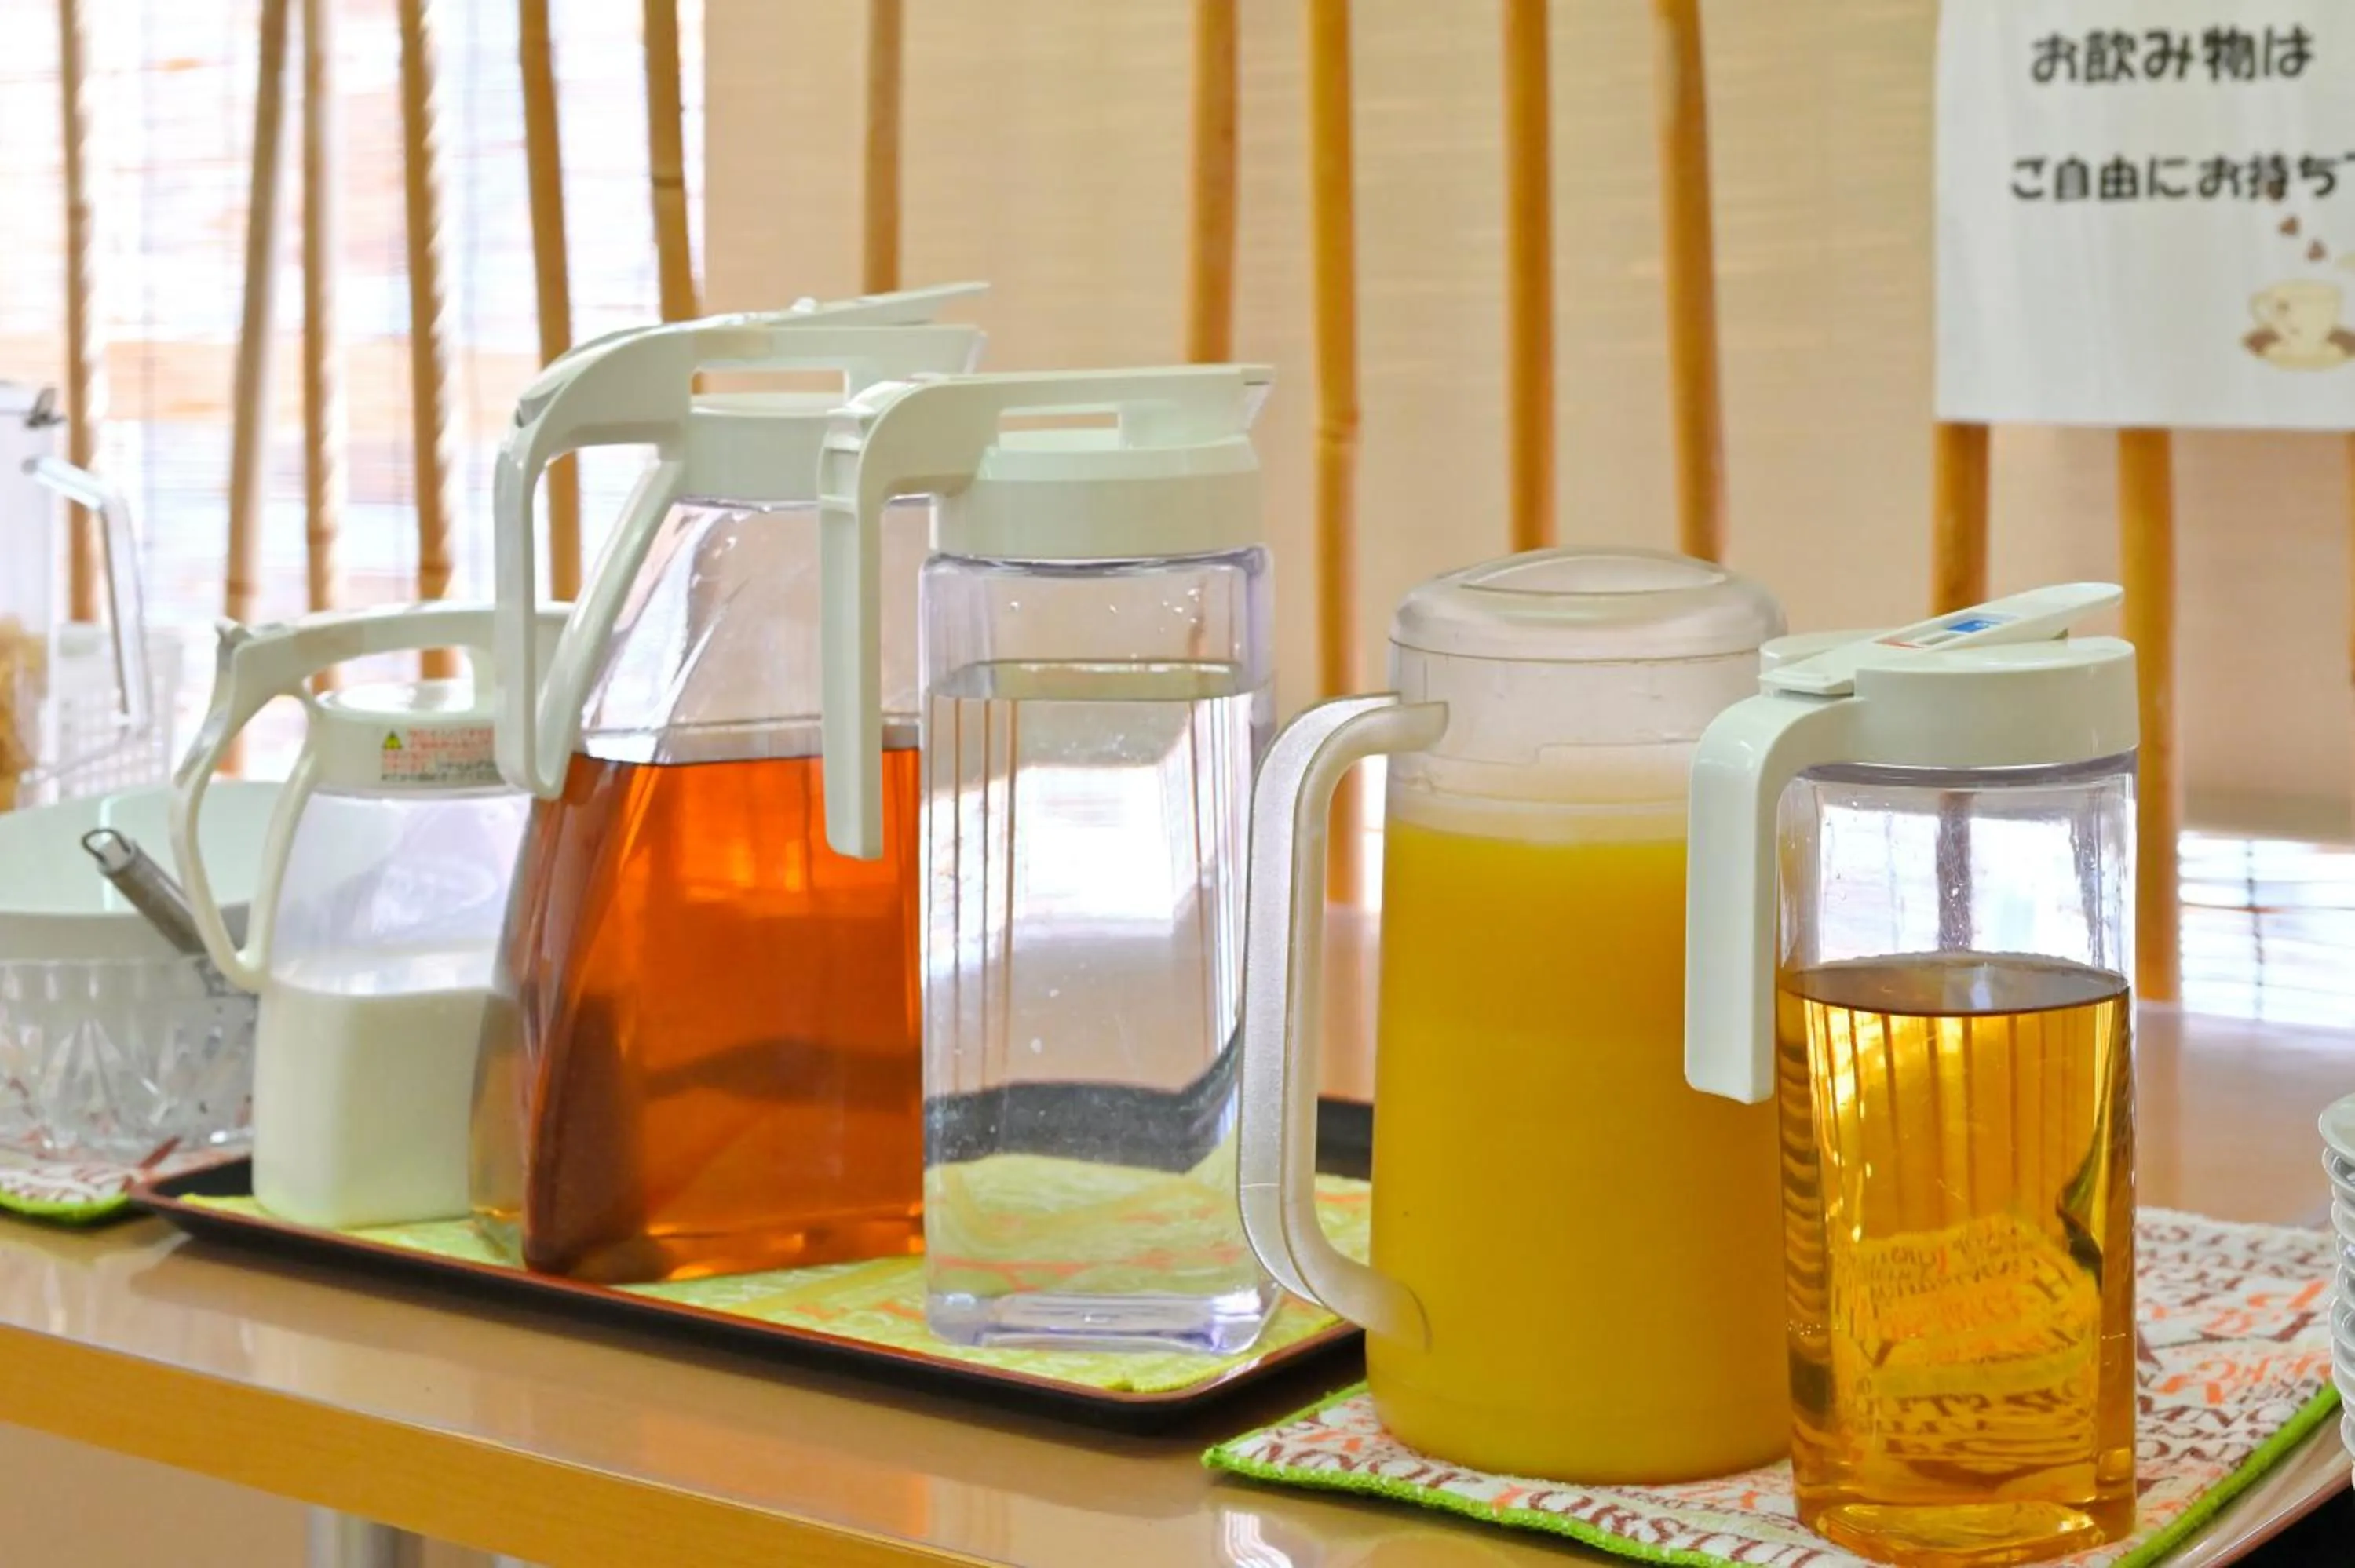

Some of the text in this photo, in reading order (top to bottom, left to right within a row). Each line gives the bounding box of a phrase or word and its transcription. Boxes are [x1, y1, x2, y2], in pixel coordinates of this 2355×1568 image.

[2030, 25, 2313, 82] お飲み物は
